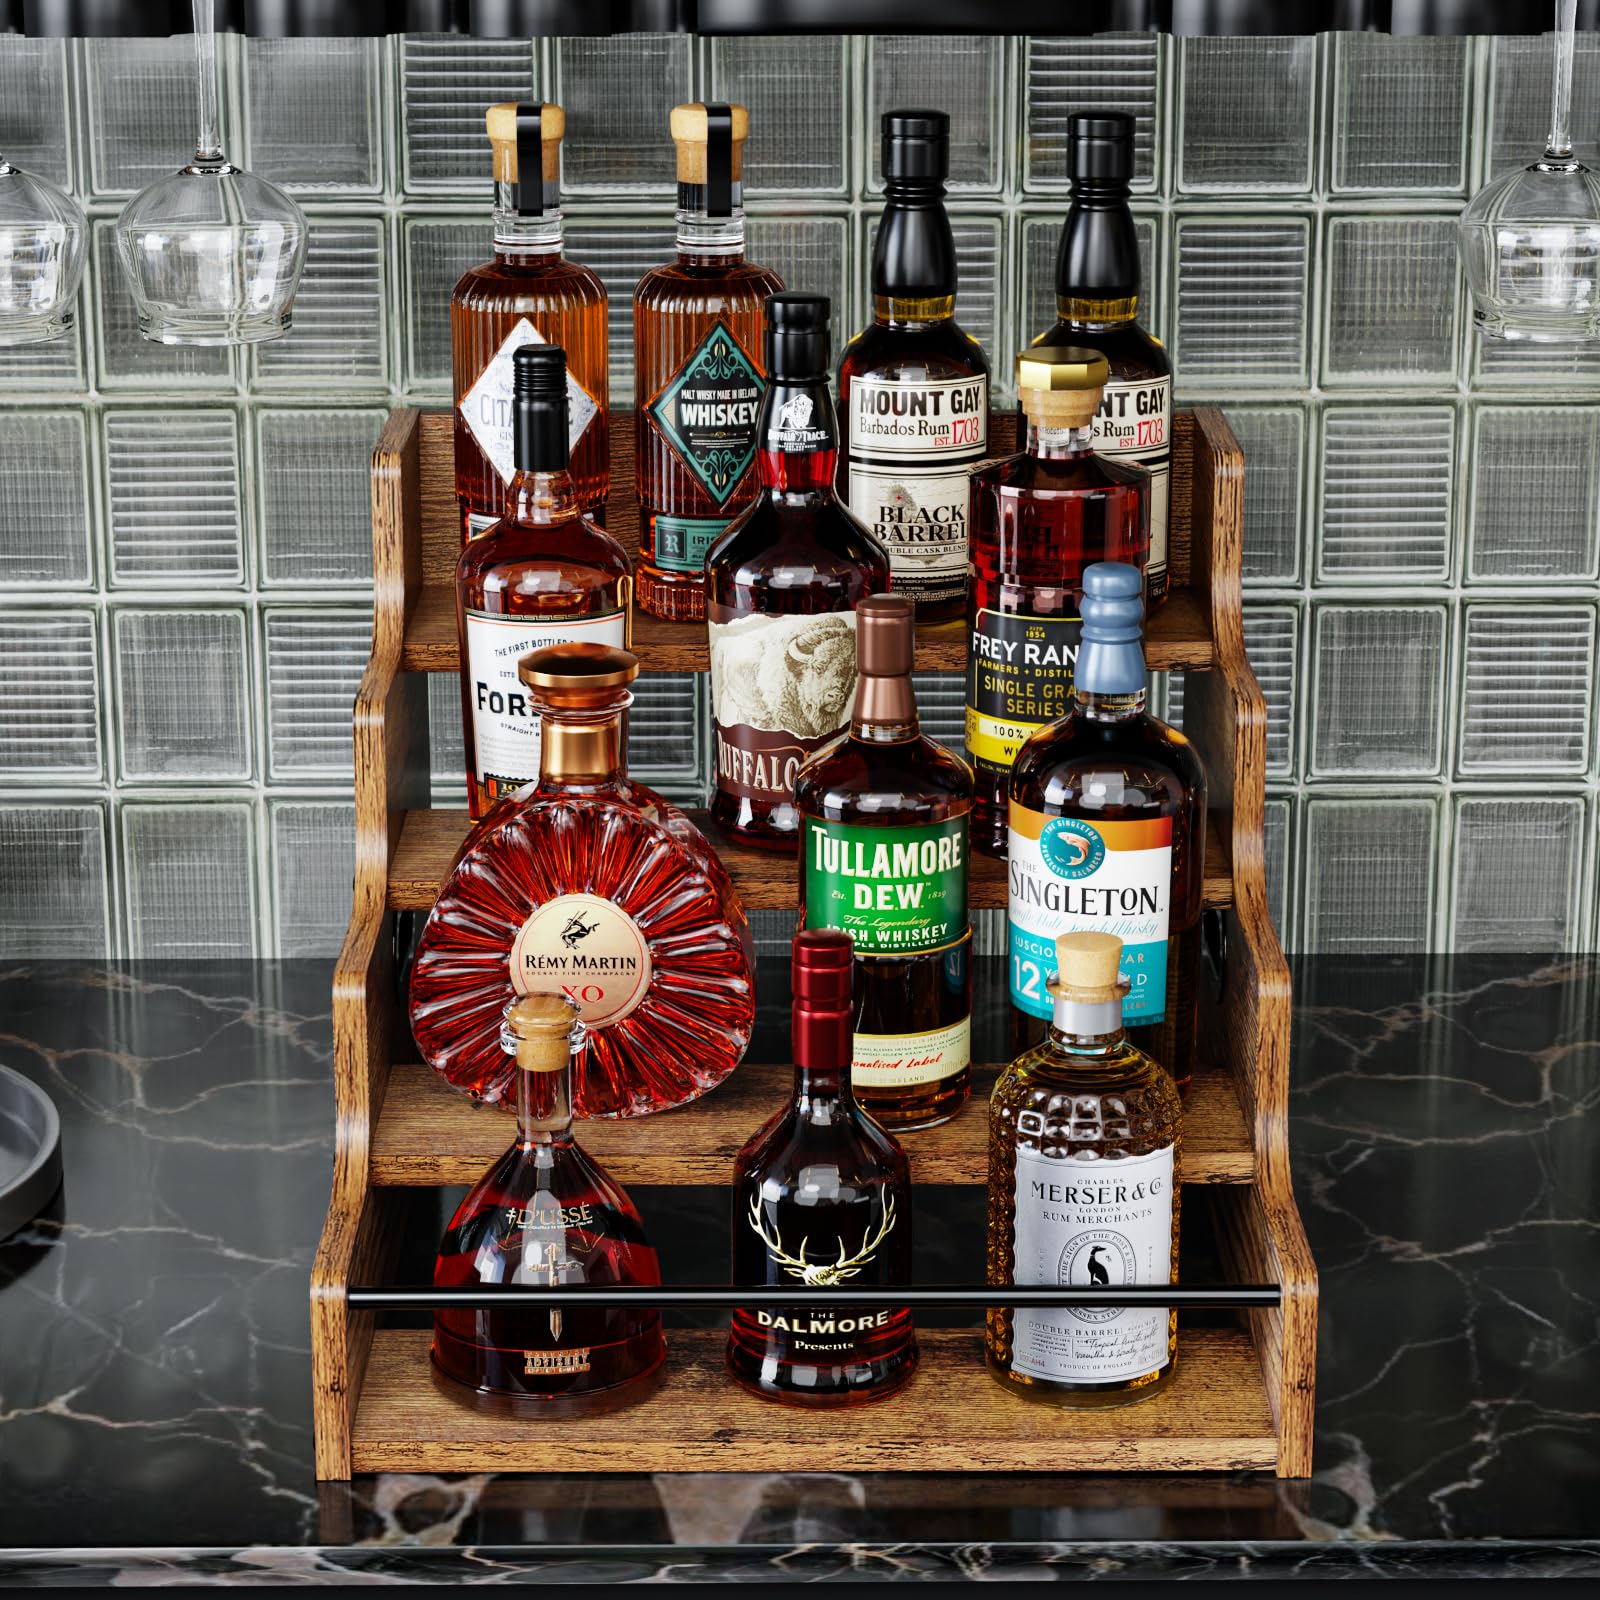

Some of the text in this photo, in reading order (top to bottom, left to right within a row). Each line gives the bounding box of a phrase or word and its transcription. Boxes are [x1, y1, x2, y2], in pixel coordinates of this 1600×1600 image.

[681, 389, 696, 399] MALT
[716, 390, 731, 399] MADE
[731, 390, 737, 399] IN
[860, 386, 980, 416] MOUNT GAY
[1136, 387, 1164, 415] GAY
[680, 402, 759, 426] WHISKEY
[860, 417, 949, 435] Barbados Rum
[934, 417, 979, 446] EST. 1703
[1103, 421, 1135, 437] Rum
[1120, 418, 1163, 447] EST. 1703
[880, 504, 965, 523] BLACK
[874, 522, 967, 541] BARREL
[943, 545, 966, 553] BLEND
[495, 648, 507, 657] THE
[508, 642, 529, 654] FIRST
[973, 632, 1079, 665] FREY RAN
[978, 659, 1019, 674] FARMERS
[1035, 669, 1074, 677] DISTIL
[984, 676, 1075, 698] SINGLE GRA
[1007, 699, 1064, 716] SERIES
[994, 726, 1023, 738] 100%
[717, 730, 800, 792] BUFFALO
[1057, 820, 1098, 840] SINGLETON
[811, 825, 962, 878] TULLAMORE
[1022, 861, 1037, 873] THE
[831, 889, 847, 900] Est.
[1011, 859, 1159, 916] SINGLETON
[843, 915, 932, 930] The Legendary
[876, 923, 948, 942] WHISKEY
[880, 939, 937, 948] DISTILLED
[1015, 935, 1057, 957] LUSCIO
[525, 955, 636, 968] RÉMY MARTIN
[1014, 955, 1040, 1000] 12
[561, 985, 604, 1002] XO
[851, 1053, 943, 1069] onalised Label
[1031, 1181, 1127, 1204] MERSER
[1043, 1208, 1152, 1223] RUM MERCHANTS
[757, 1311, 889, 1334] DALMORE
[1029, 1321, 1070, 1335] DOUBLE
[794, 1341, 854, 1350] Presents
